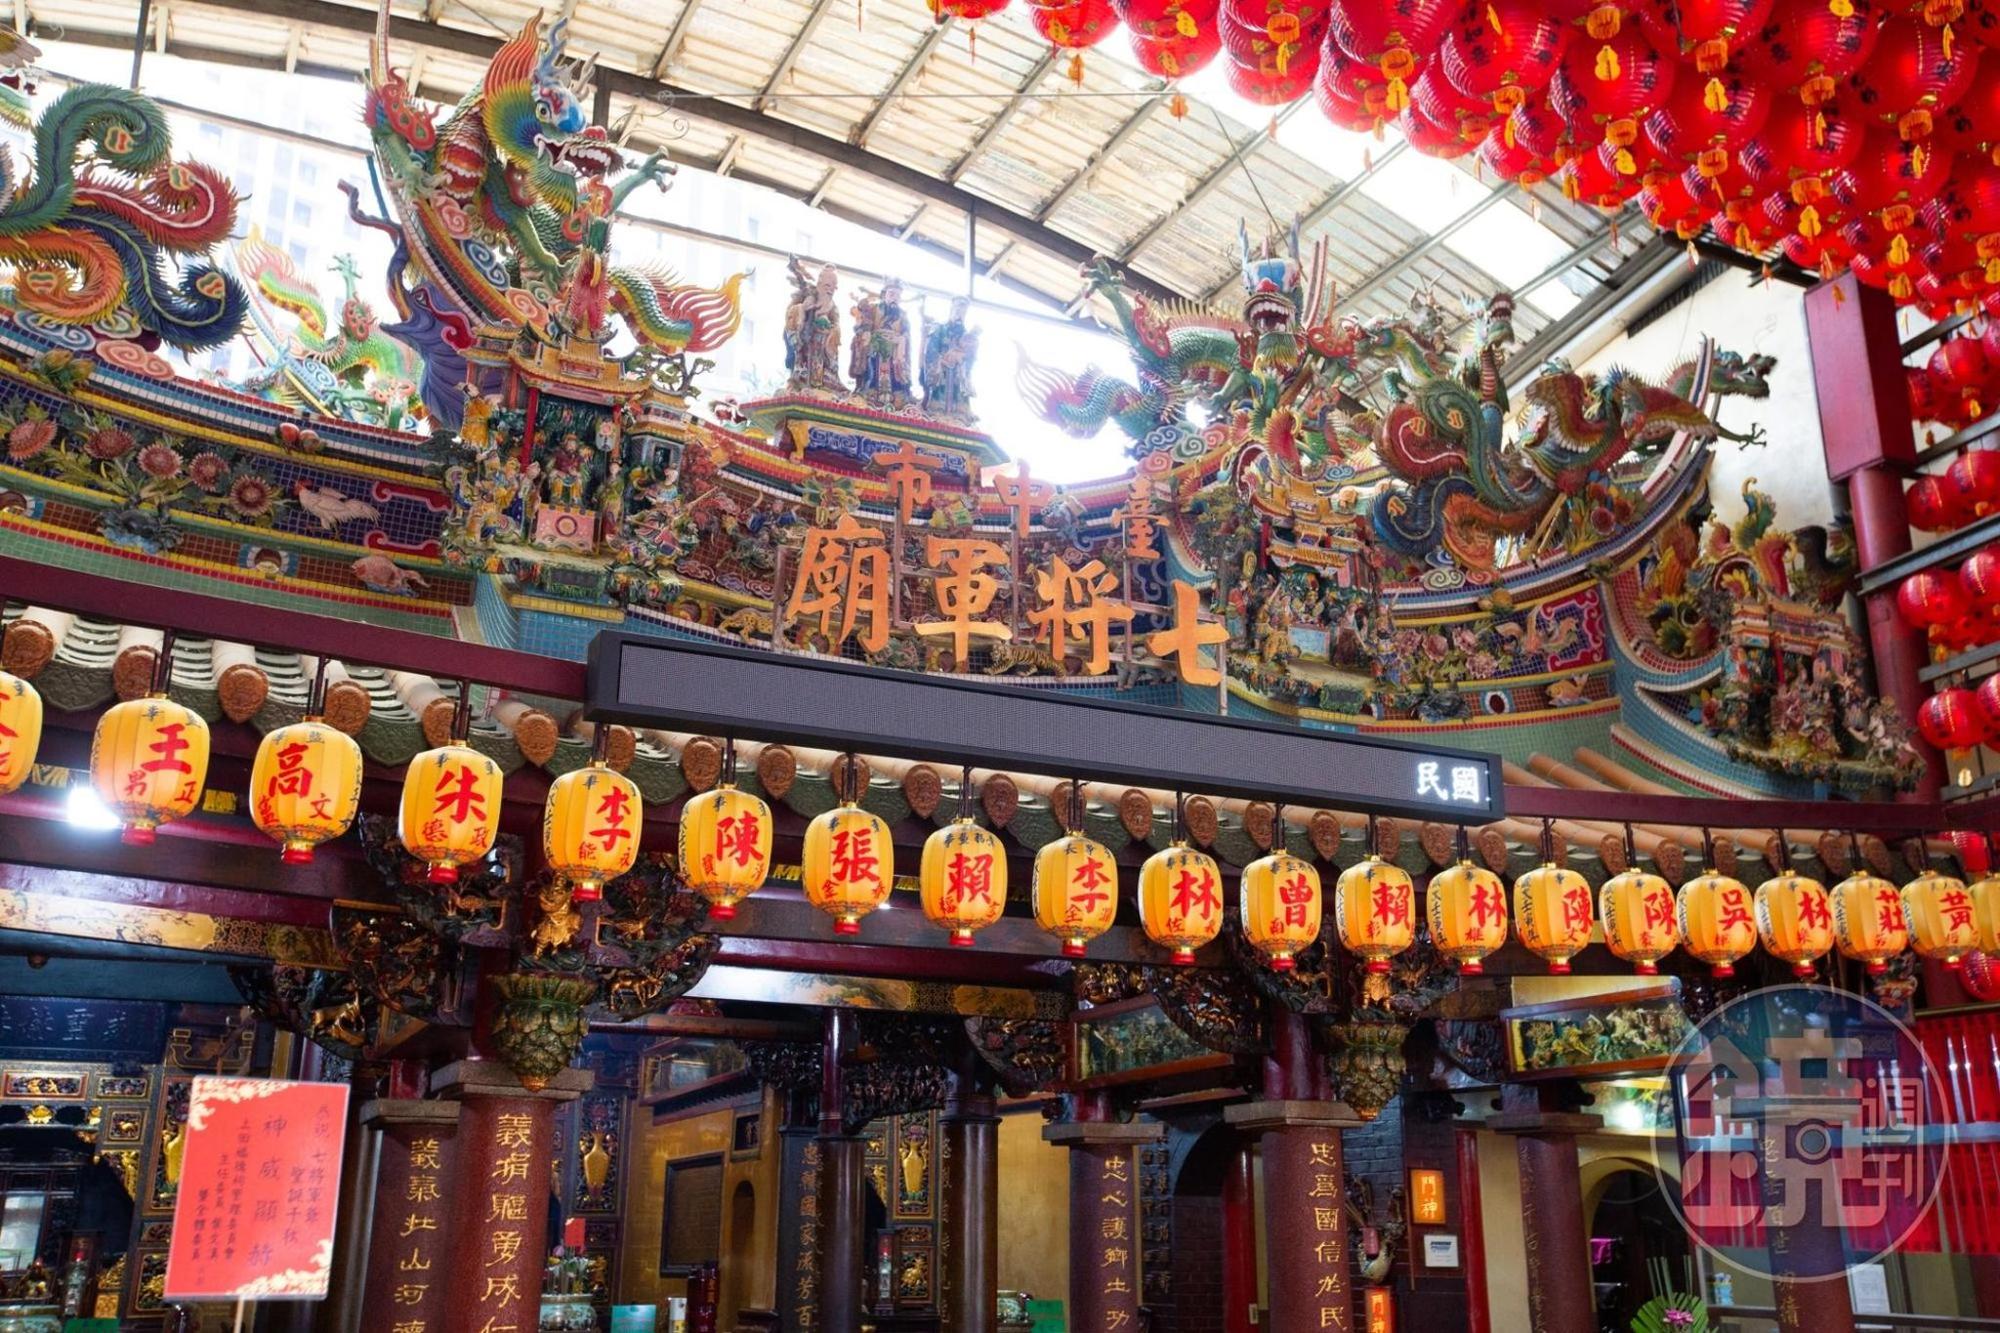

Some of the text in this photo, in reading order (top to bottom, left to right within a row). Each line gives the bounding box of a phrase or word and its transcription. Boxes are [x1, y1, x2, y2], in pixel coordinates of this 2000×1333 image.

[785, 513, 1231, 687] 七將軍廟
[141, 723, 192, 774] 王
[269, 742, 313, 798] 高
[433, 765, 487, 824] 朱
[1416, 761, 1480, 804] 民國
[590, 786, 631, 851] 李
[717, 810, 764, 867] 陳
[832, 828, 881, 883] 張
[947, 853, 993, 904] 賴
[1070, 856, 1112, 914] 李
[1170, 867, 1221, 920] 林
[1279, 873, 1313, 928] 曾
[1372, 882, 1411, 930] 賴
[1468, 881, 1506, 928] 林
[1563, 885, 1593, 934] 陳
[1798, 889, 1832, 930] 林
[1939, 890, 1973, 931] 黃
[1643, 887, 1677, 936] 陳
[1421, 1175, 1438, 1219] 門神
